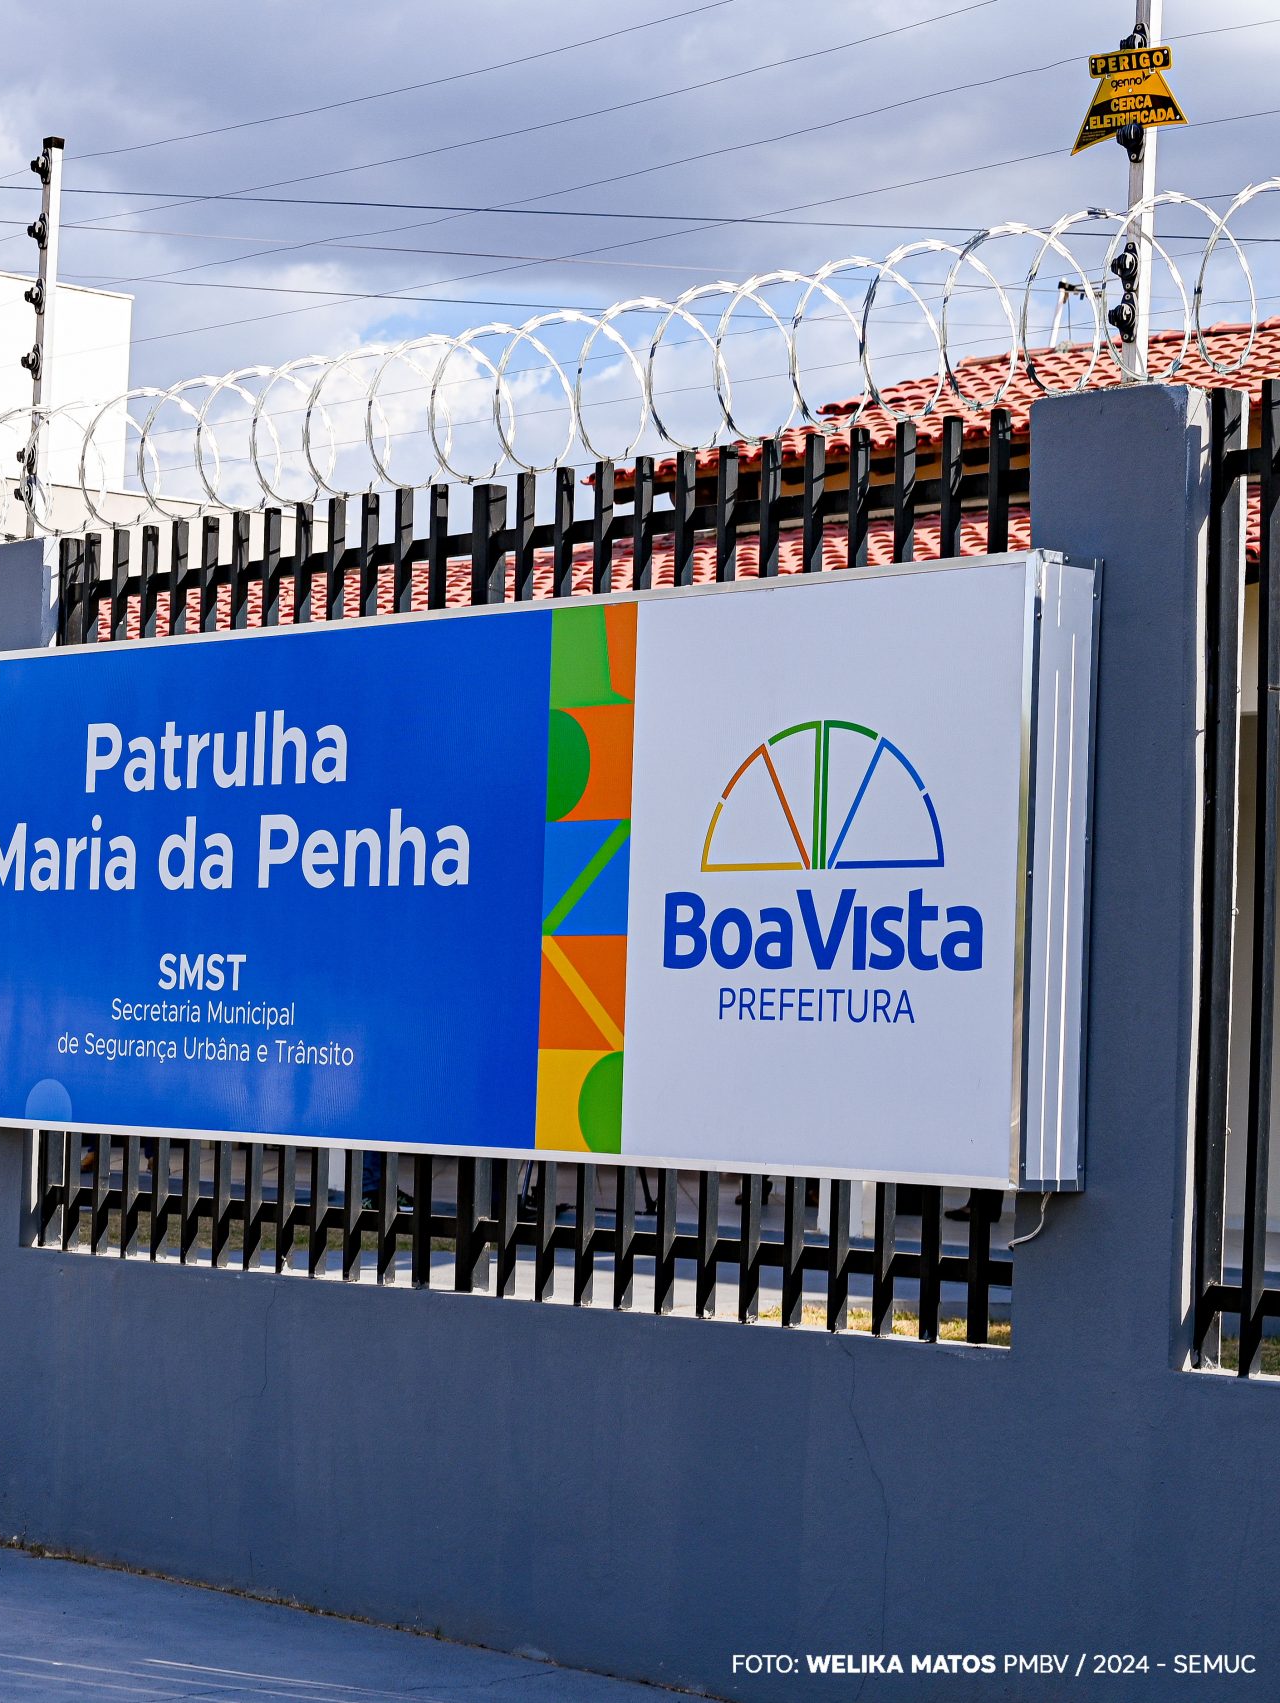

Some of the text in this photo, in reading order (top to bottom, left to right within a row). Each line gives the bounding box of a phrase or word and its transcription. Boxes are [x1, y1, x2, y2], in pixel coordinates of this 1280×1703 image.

[1096, 51, 1164, 73] PERIGO
[1110, 76, 1143, 91] genno
[1089, 107, 1175, 129] ELETRIFICADA
[1110, 95, 1152, 112] CERCA
[85, 709, 348, 793] Patrulha
[158, 815, 234, 891] da
[257, 808, 470, 889] Penha
[157, 953, 247, 991] SMST
[111, 997, 295, 1030] Secretaria Municipal
[718, 987, 915, 1024] PREFEITURA
[57, 1031, 354, 1066] de Segurança Urbâna e Trânsito
